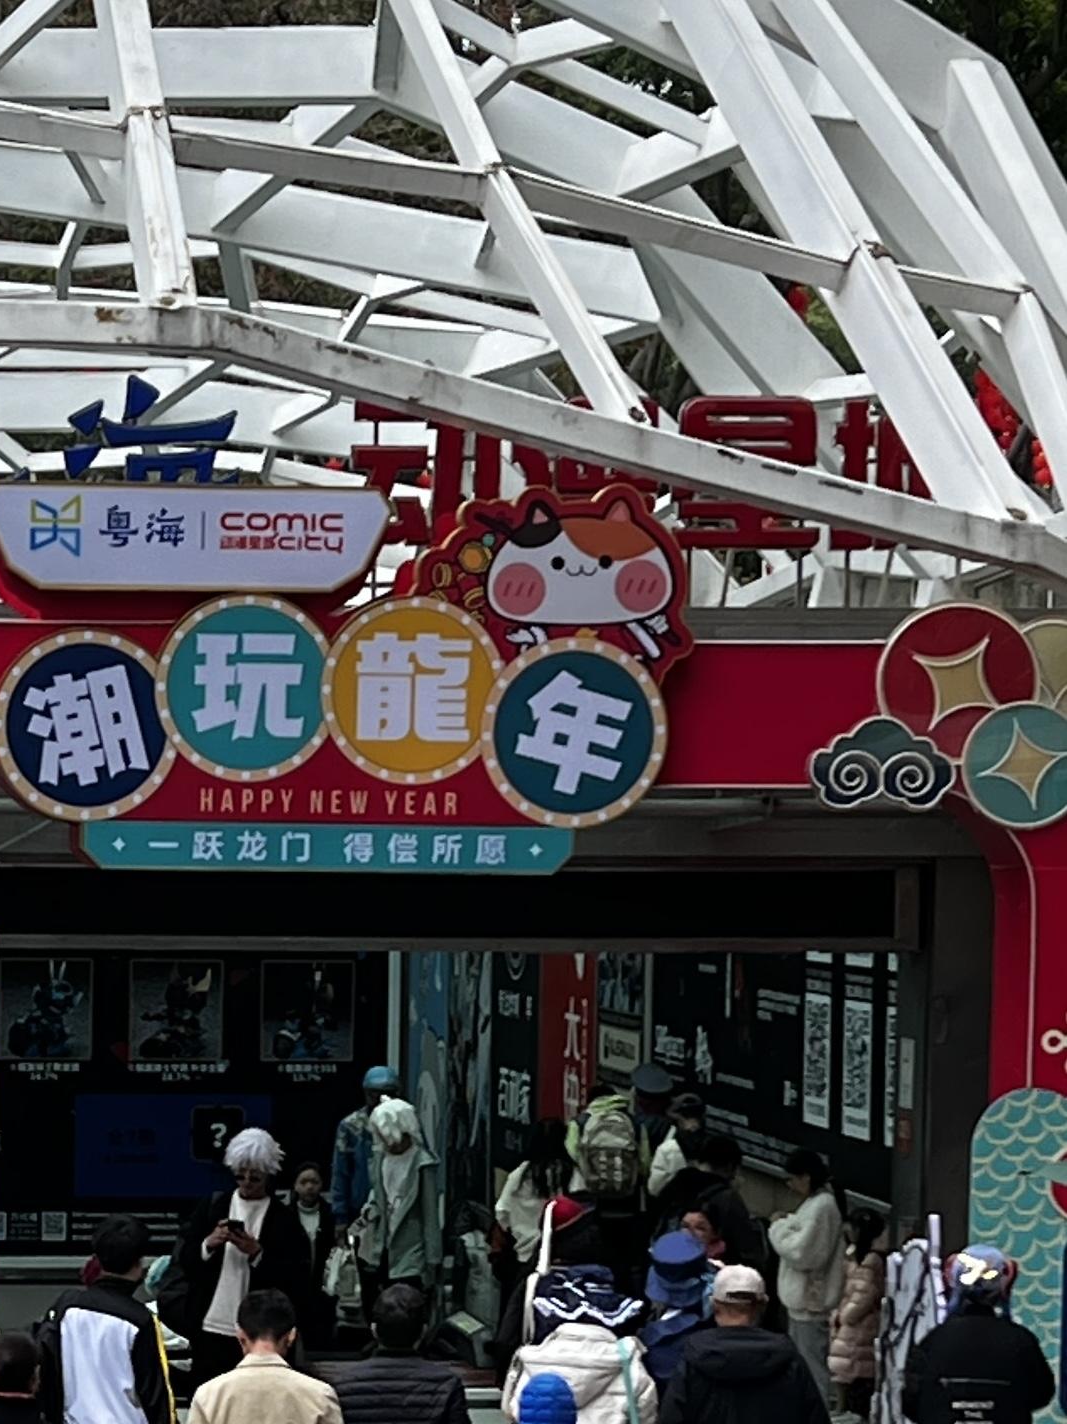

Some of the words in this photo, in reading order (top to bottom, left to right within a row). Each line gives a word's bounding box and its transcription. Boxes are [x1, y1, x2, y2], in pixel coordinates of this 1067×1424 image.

[98, 504, 186, 548] 粤海
[23, 631, 632, 796] 潮玩龍年
[199, 788, 293, 814] HAPPY
[310, 790, 368, 815] NEW
[385, 790, 459, 817] YEAR
[148, 832, 312, 863] 一跃龙门
[343, 833, 508, 866] 得偿所愿
